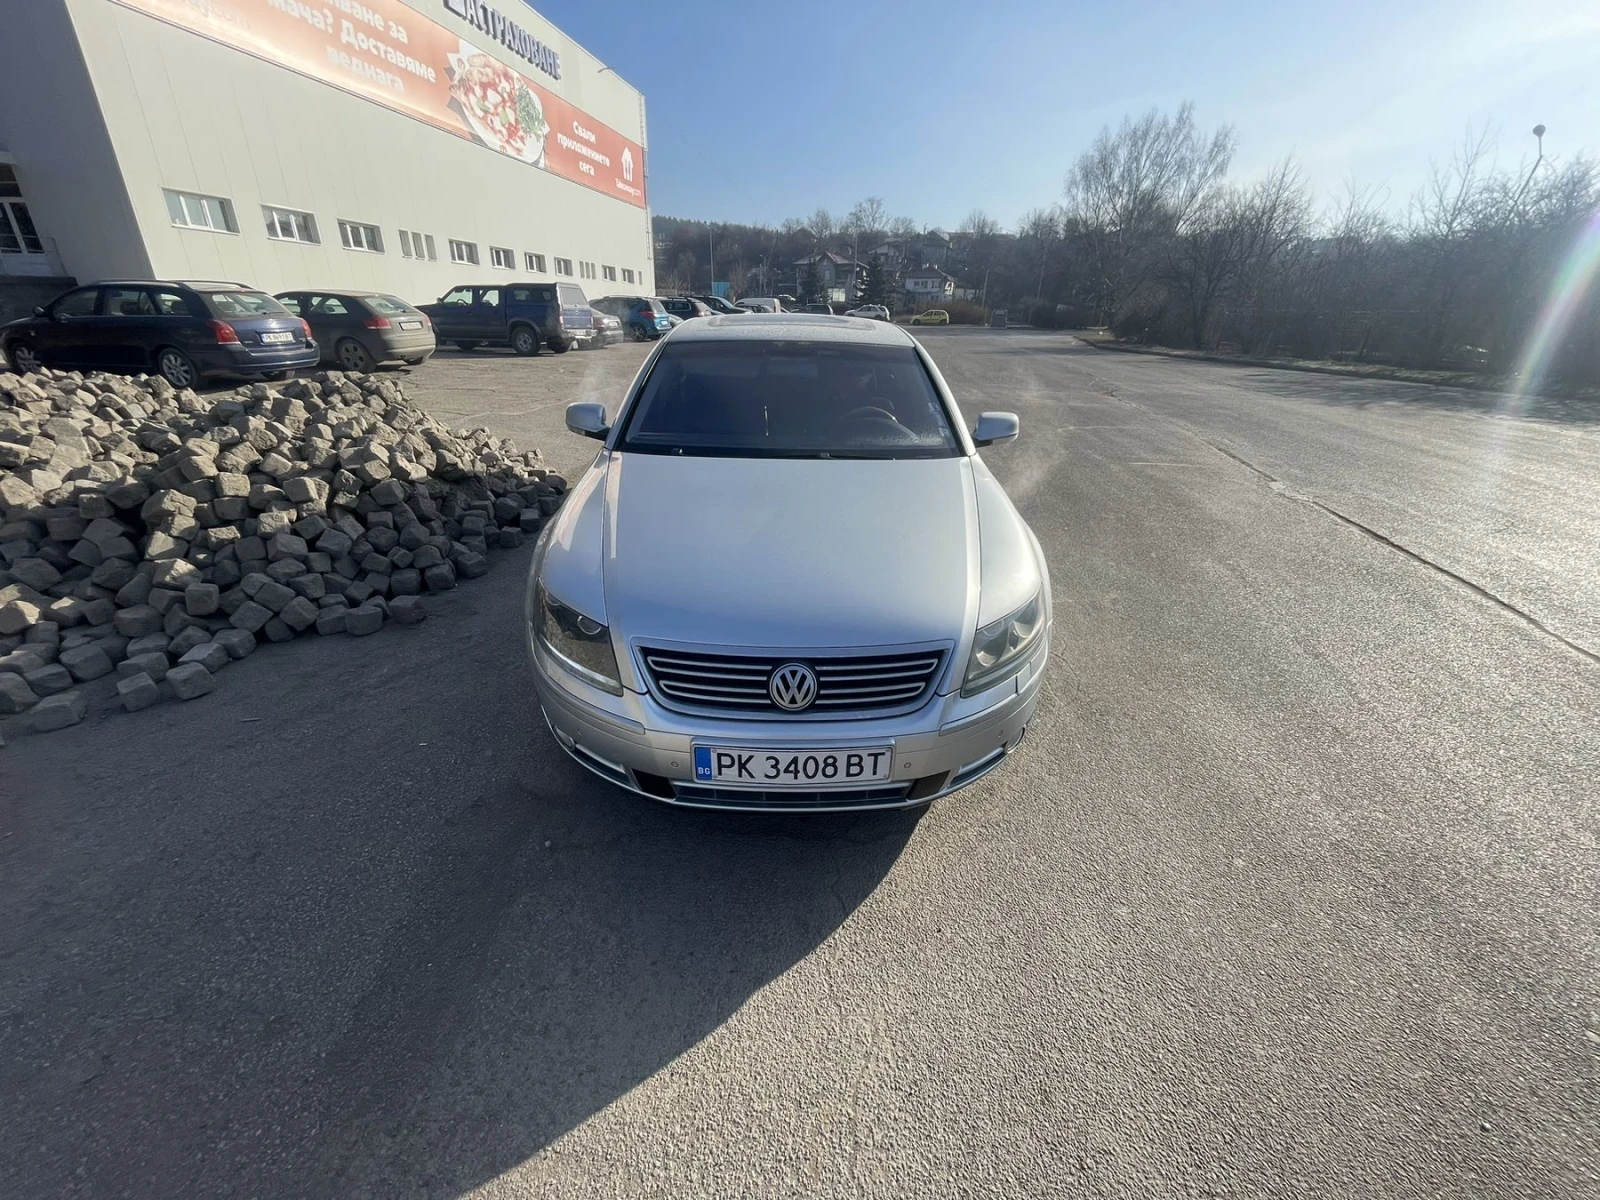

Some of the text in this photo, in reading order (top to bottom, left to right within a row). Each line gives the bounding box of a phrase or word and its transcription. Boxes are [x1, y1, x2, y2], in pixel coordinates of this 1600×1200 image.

[388, 20, 409, 44] за
[340, 18, 436, 83] Доставяме
[326, 45, 405, 93] веднага
[572, 120, 597, 144] Свали
[556, 132, 610, 168] приложението
[579, 160, 595, 177] сега
[774, 668, 815, 707] VW
[697, 766, 711, 775] BG
[716, 752, 886, 780] PK 3408 BT
